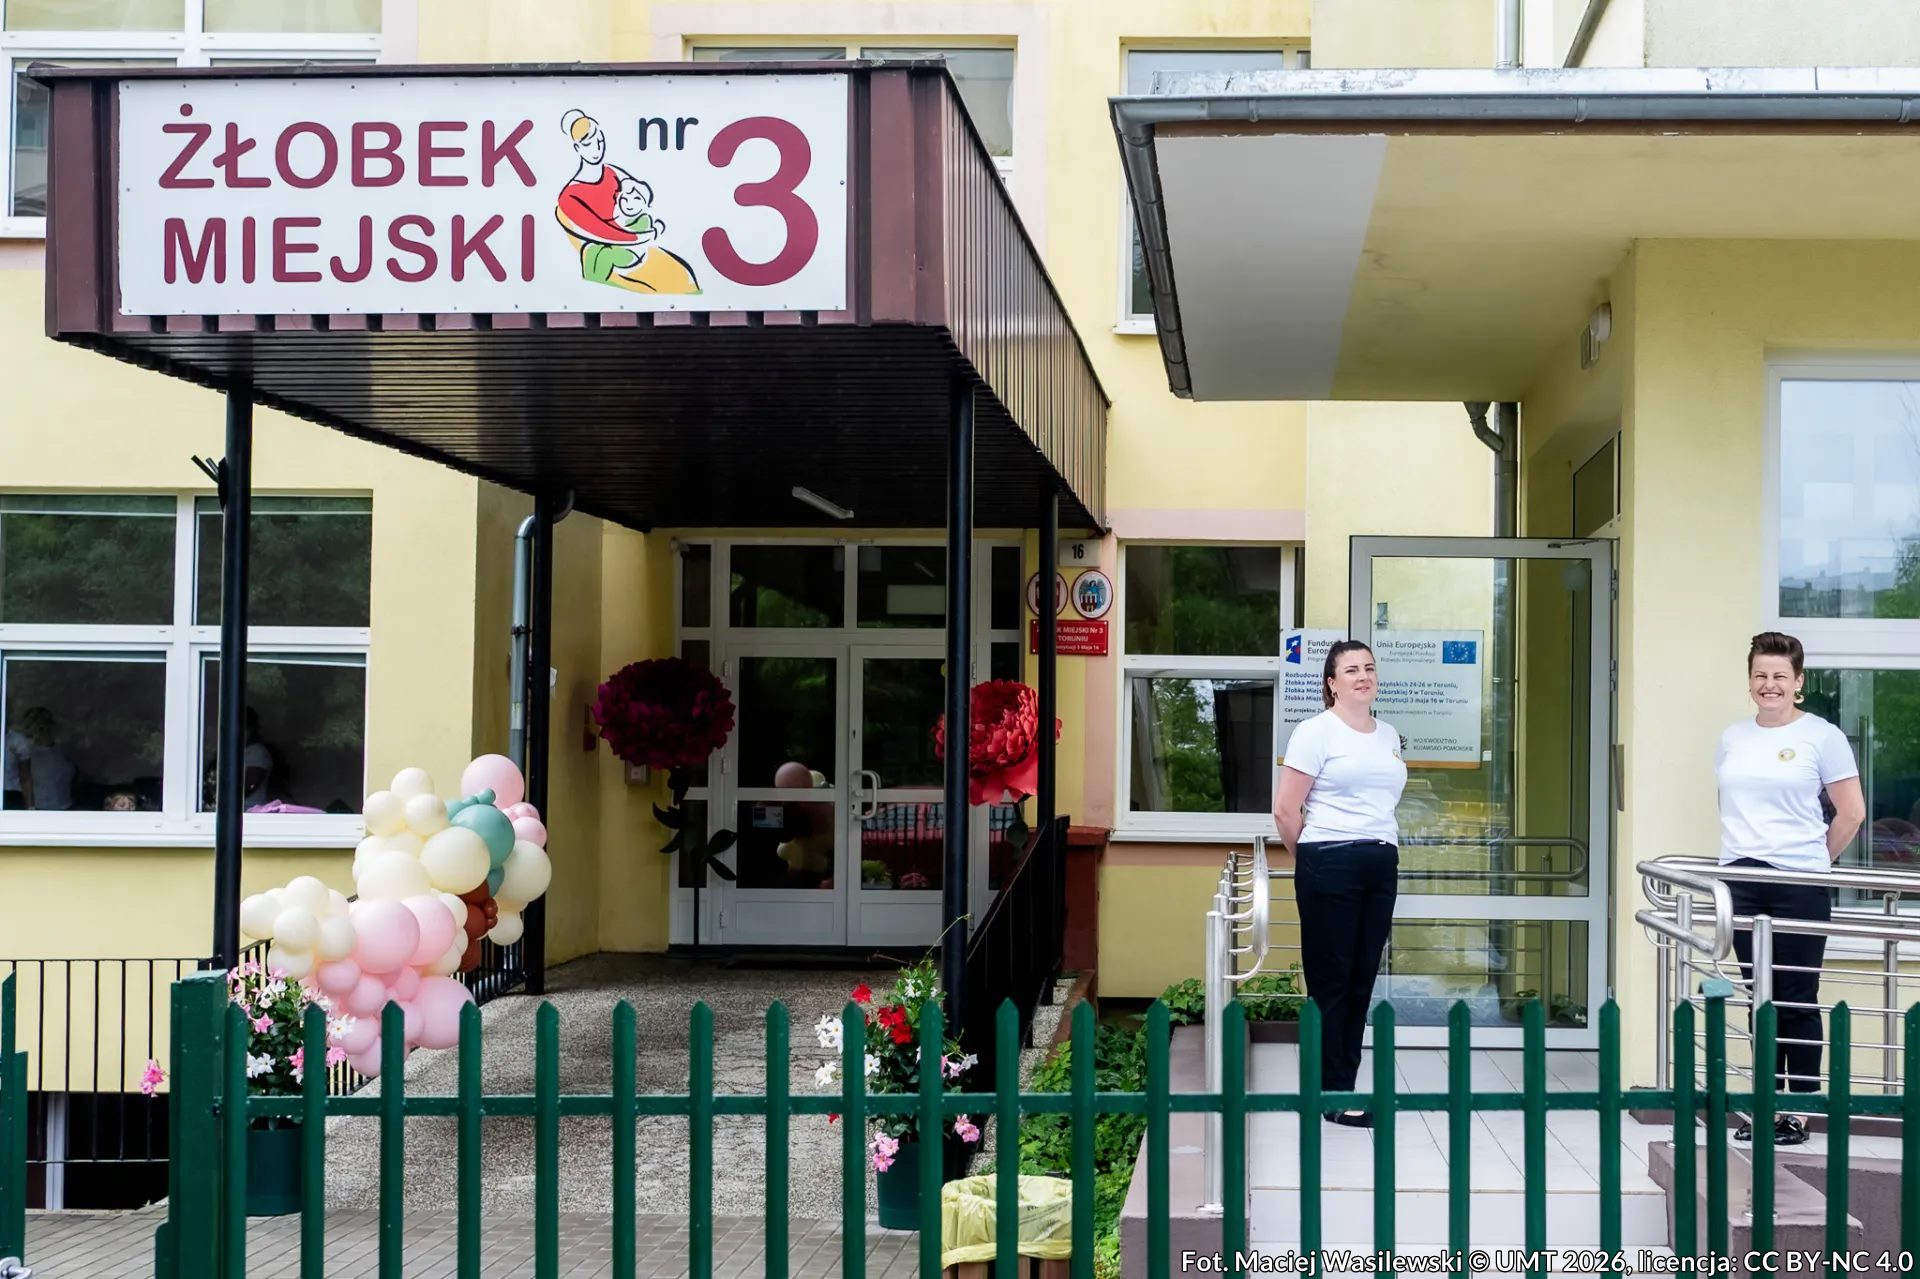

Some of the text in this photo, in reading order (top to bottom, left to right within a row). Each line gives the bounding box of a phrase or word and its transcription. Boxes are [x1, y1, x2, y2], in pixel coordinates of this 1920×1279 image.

[158, 103, 537, 189] ŻŁOBEK
[638, 116, 819, 287] nr 3
[164, 214, 535, 284] MIEJSKI
[1072, 543, 1084, 559] 16
[1063, 626, 1089, 634] MIEJSKI
[1395, 641, 1436, 650] Europejska
